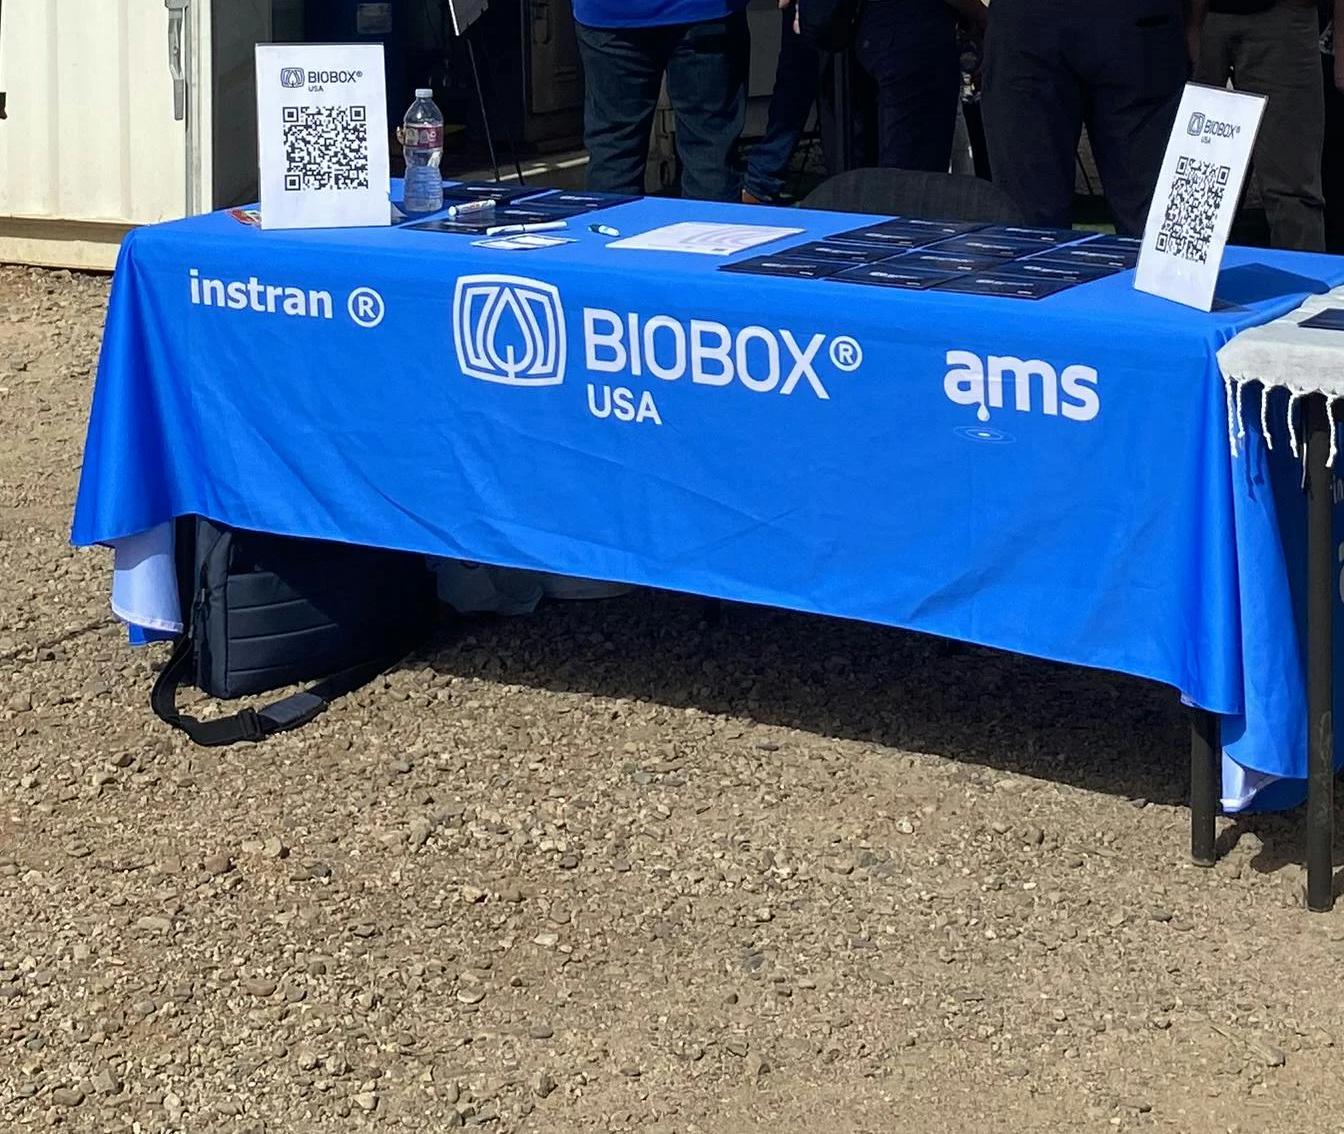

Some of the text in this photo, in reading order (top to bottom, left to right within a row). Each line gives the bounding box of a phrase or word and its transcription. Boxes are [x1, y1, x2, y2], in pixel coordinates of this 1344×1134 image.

[190, 268, 333, 320] instran
[586, 383, 662, 425] USA
[943, 349, 1100, 422] ams
